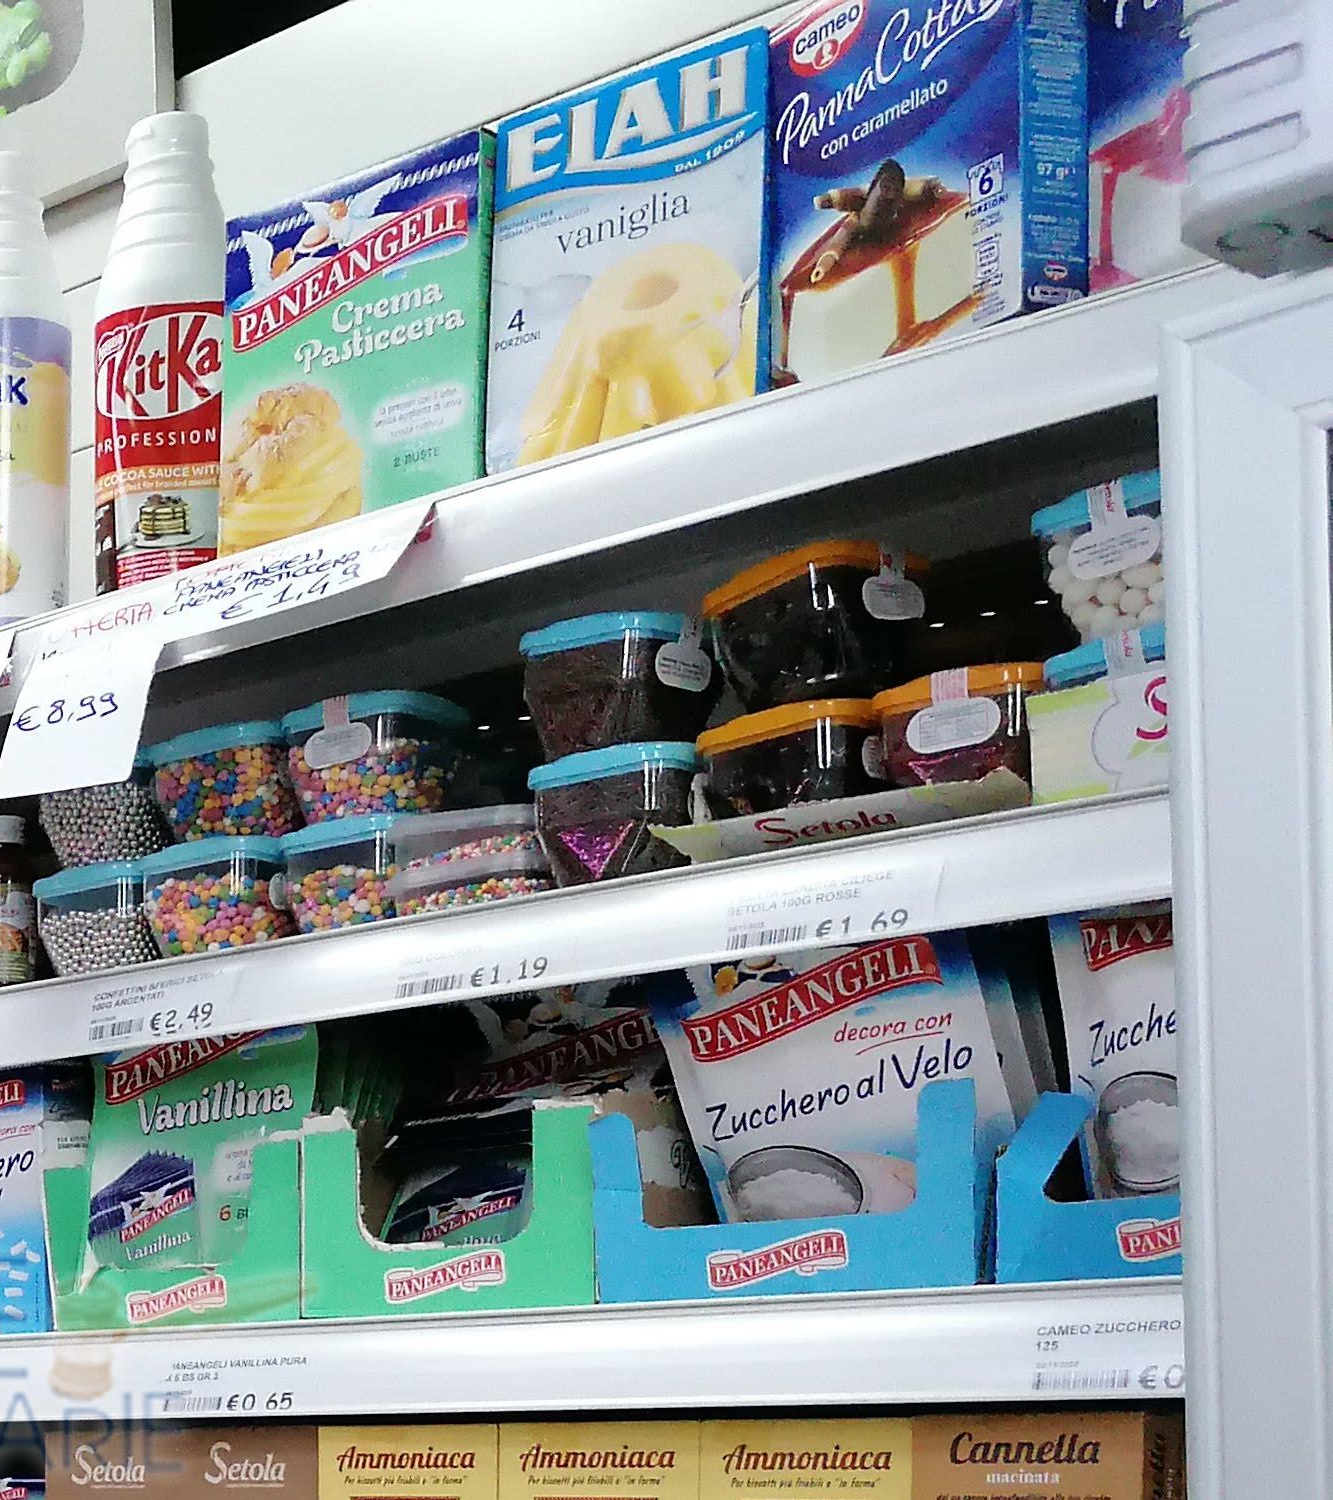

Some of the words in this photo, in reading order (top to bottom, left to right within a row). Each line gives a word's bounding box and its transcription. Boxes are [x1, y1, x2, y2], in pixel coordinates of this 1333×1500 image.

[794, 5, 861, 56] cameo
[506, 44, 751, 192] ELAH
[820, 131, 848, 160] con
[850, 76, 949, 146] caramellato
[976, 169, 993, 196] 6
[557, 189, 692, 254] vaniglia
[237, 198, 467, 348] PANEANGELI
[333, 283, 444, 334] Crema
[508, 309, 525, 333] 4
[294, 307, 465, 373] Pasticcera
[494, 330, 542, 353] PORZIONI
[104, 314, 223, 417] KitKa
[148, 466, 191, 480] SAUCE
[755, 810, 898, 847] Setola
[694, 942, 925, 1055] PANEANGELI
[834, 1019, 907, 1044] decora
[913, 1011, 951, 1033] con
[892, 1042, 973, 1088] Velo
[137, 1079, 293, 1136] Vanillina
[705, 1081, 849, 1141] Zucchero
[856, 1070, 885, 1105] al
[120, 1188, 192, 1243] PANEANGELI
[124, 1232, 191, 1262] Vanillina
[713, 1237, 844, 1286] PANEANGELI
[390, 1254, 502, 1299] PANEANGELI
[130, 1281, 225, 1319] PANEANGELI
[1037, 1324, 1091, 1338] CAMEO
[1096, 1319, 1181, 1335] ZUCCHERO
[72, 1445, 146, 1486] Setola
[205, 1441, 286, 1486] Setola
[337, 1445, 476, 1473] Ammoniaca
[519, 1443, 676, 1472] Ammoniaca
[723, 1444, 892, 1474] Ammoniaca
[950, 1431, 1101, 1466] Cannella
